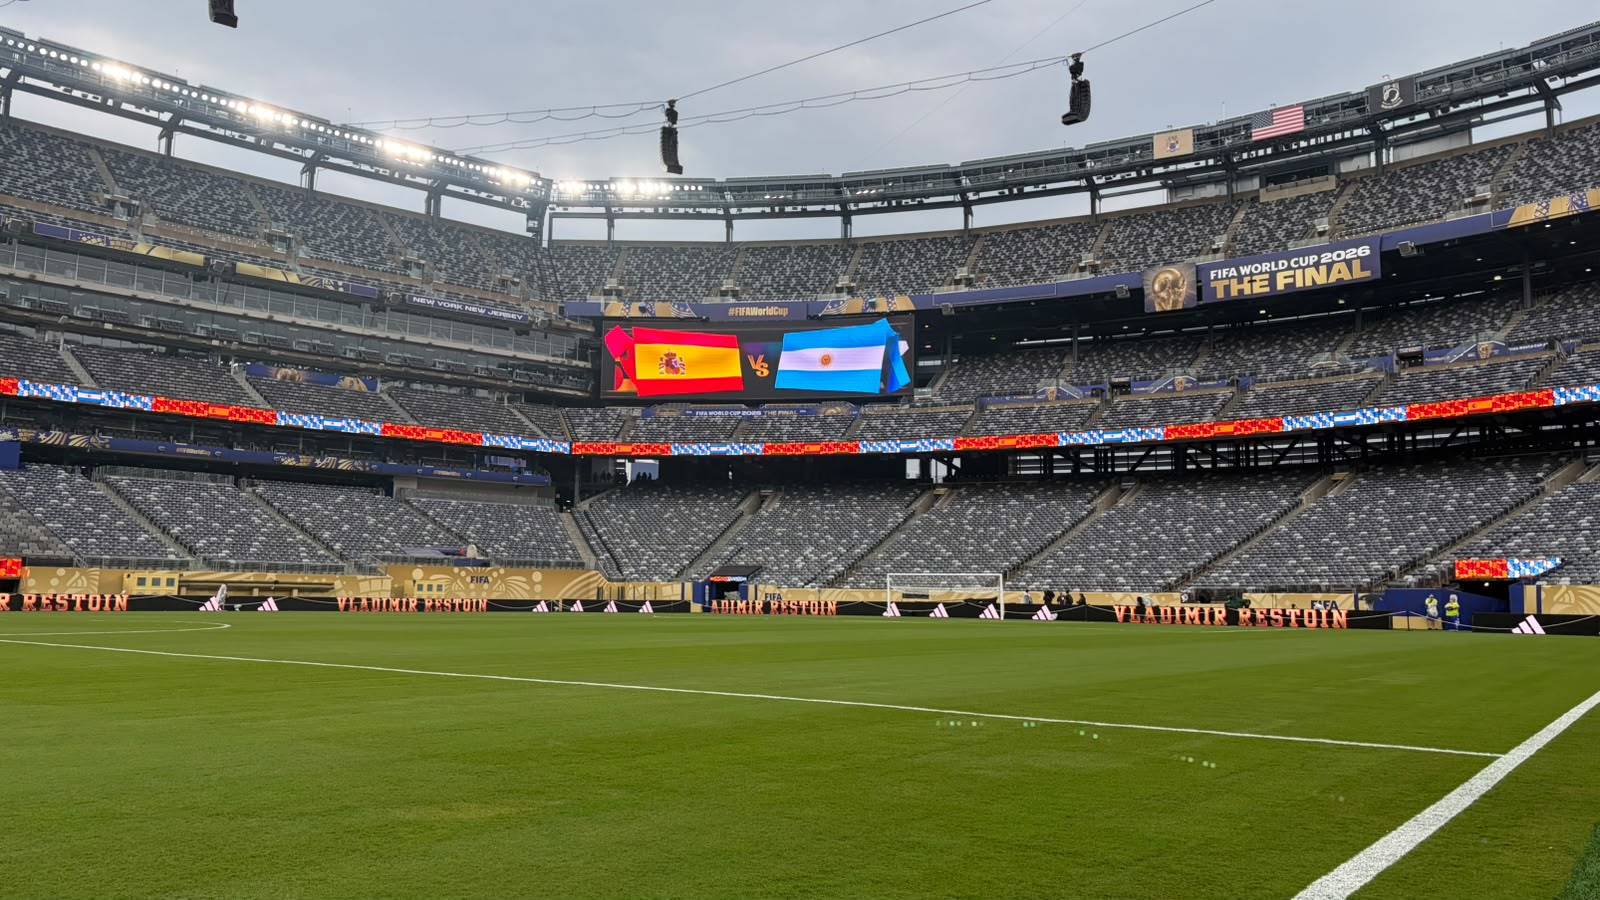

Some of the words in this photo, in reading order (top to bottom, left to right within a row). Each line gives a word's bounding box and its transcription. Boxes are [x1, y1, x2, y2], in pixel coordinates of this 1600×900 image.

[1210, 267, 1238, 280] FIFA
[1239, 259, 1288, 276] WORLD
[1290, 255, 1319, 268] CUP
[1320, 245, 1371, 263] 2026
[1210, 273, 1270, 299] THE
[1276, 259, 1372, 291] FINAL
[413, 296, 435, 306] NEW
[437, 302, 464, 311] YORK
[465, 305, 487, 313] NEW
[487, 310, 523, 320] JERSEY
[728, 306, 789, 317] #FIFAWorldCup
[747, 354, 770, 378] VS
[470, 576, 490, 584] FIFA
[0, 593, 11, 611] R
[22, 593, 131, 611] RESTOIN
[337, 597, 418, 612] VLADIMIR
[424, 598, 489, 613] RESTOIN
[765, 592, 783, 601] FIFA
[770, 600, 838, 616] RESTOIN
[1113, 605, 1228, 625] VLADIMIR
[1238, 607, 1349, 629] RESTOIN
